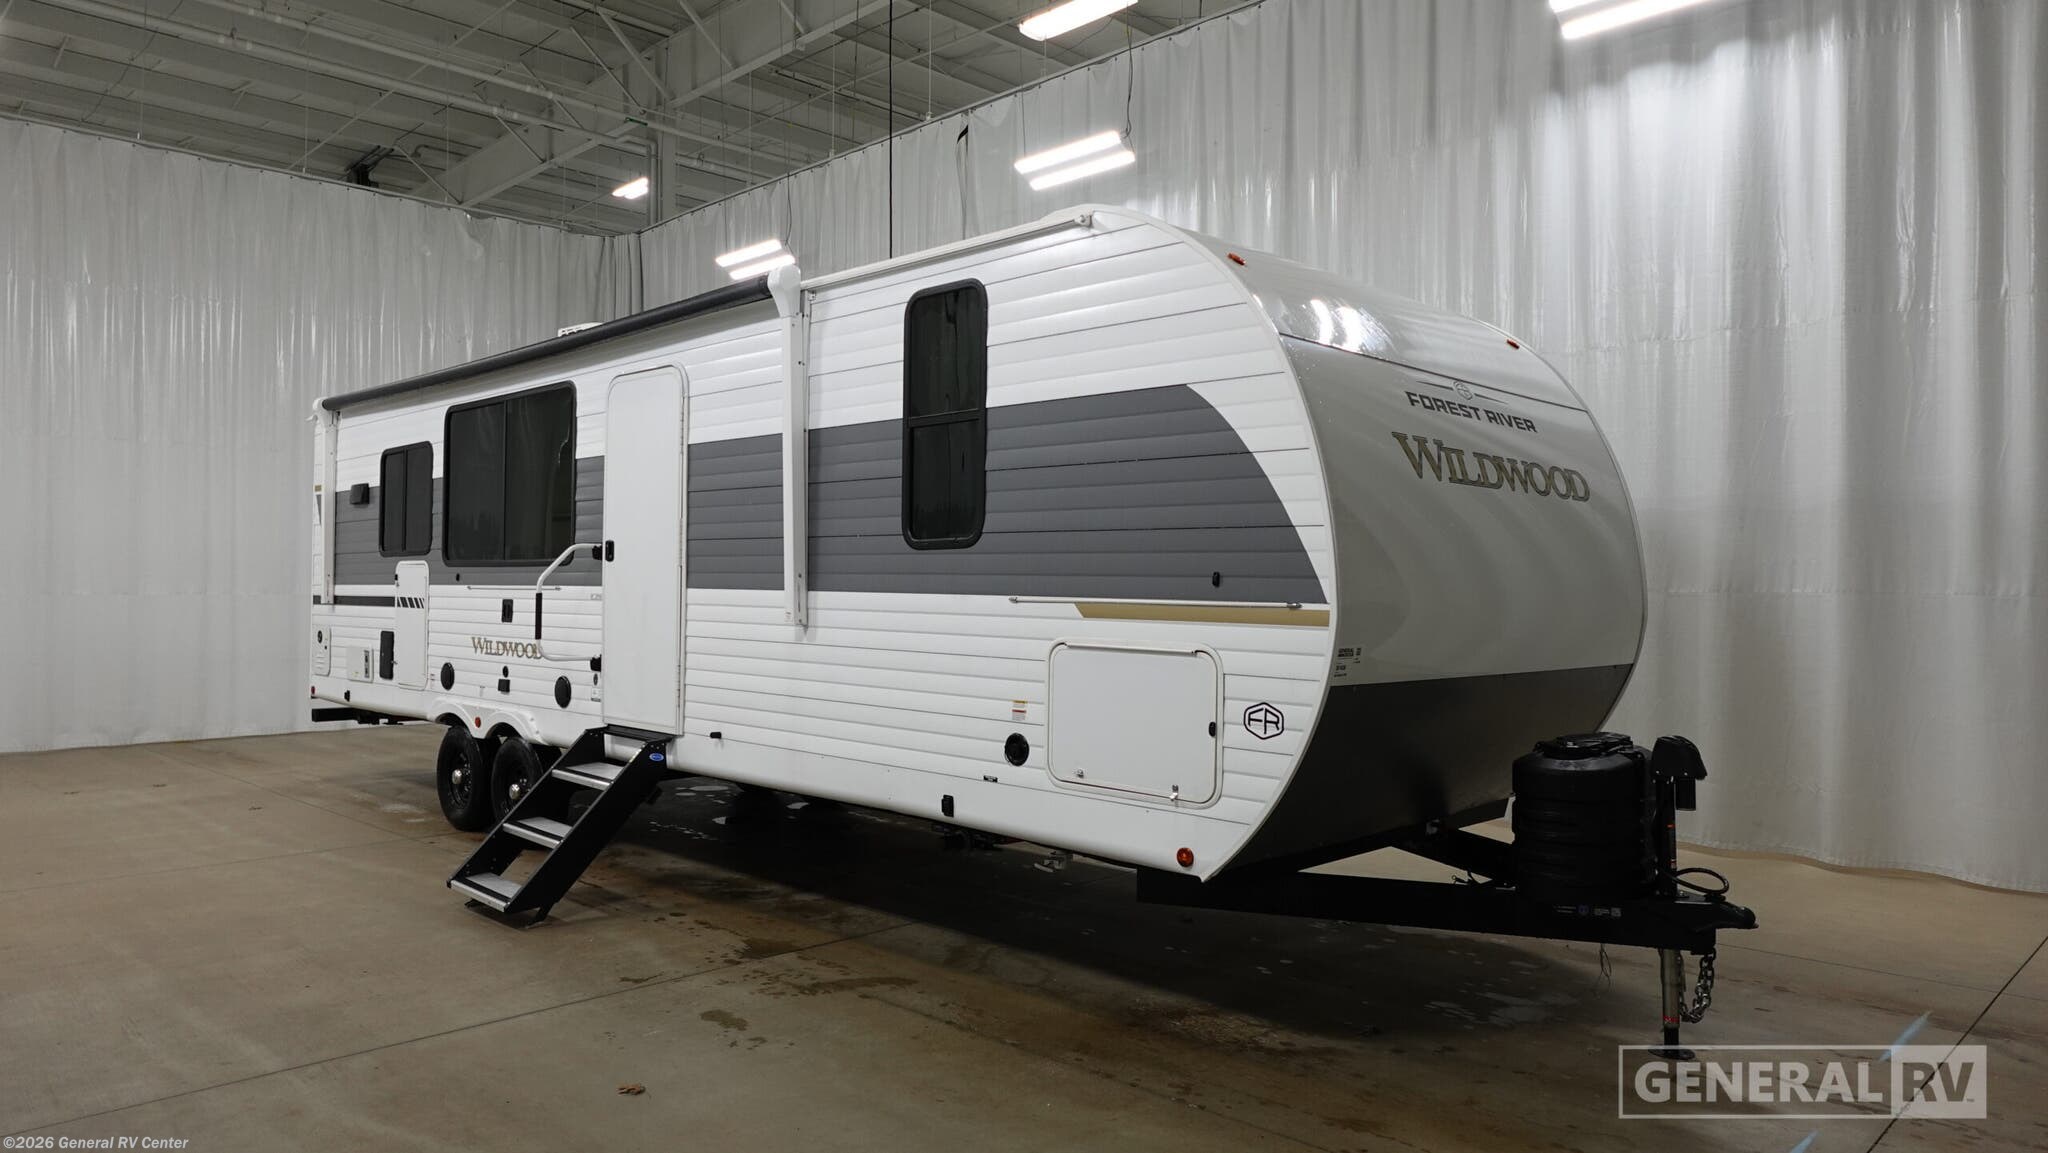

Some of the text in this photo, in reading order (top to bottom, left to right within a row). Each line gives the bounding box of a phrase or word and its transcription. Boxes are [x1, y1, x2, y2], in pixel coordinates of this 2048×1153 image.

[1405, 391, 1537, 432] FOREST RIVER
[1392, 431, 1590, 502] WILDWOOD
